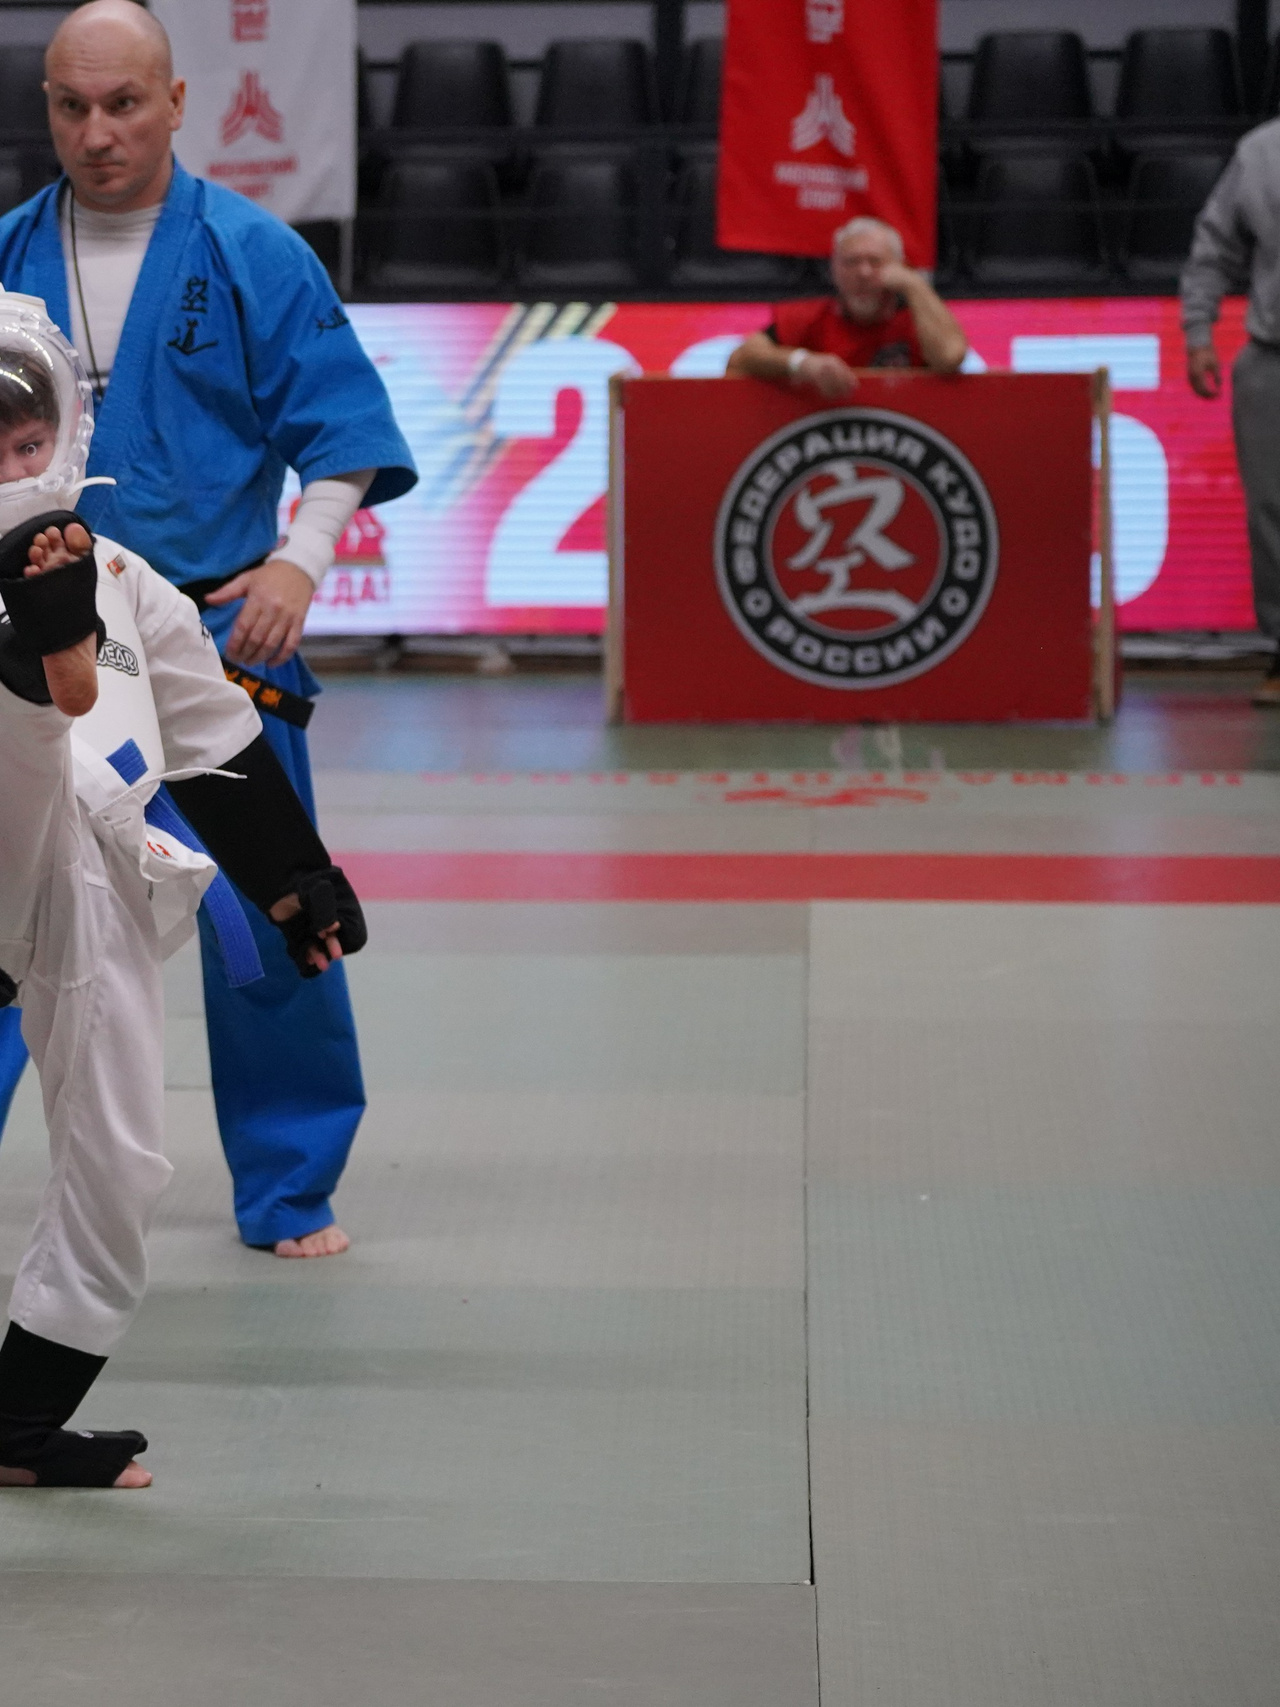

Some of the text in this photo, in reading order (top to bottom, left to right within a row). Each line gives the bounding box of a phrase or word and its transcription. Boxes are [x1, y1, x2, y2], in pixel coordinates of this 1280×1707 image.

[732, 423, 983, 586] ФЕДЕРАЦИЯ КУДО
[765, 614, 948, 674] РОССИИ
